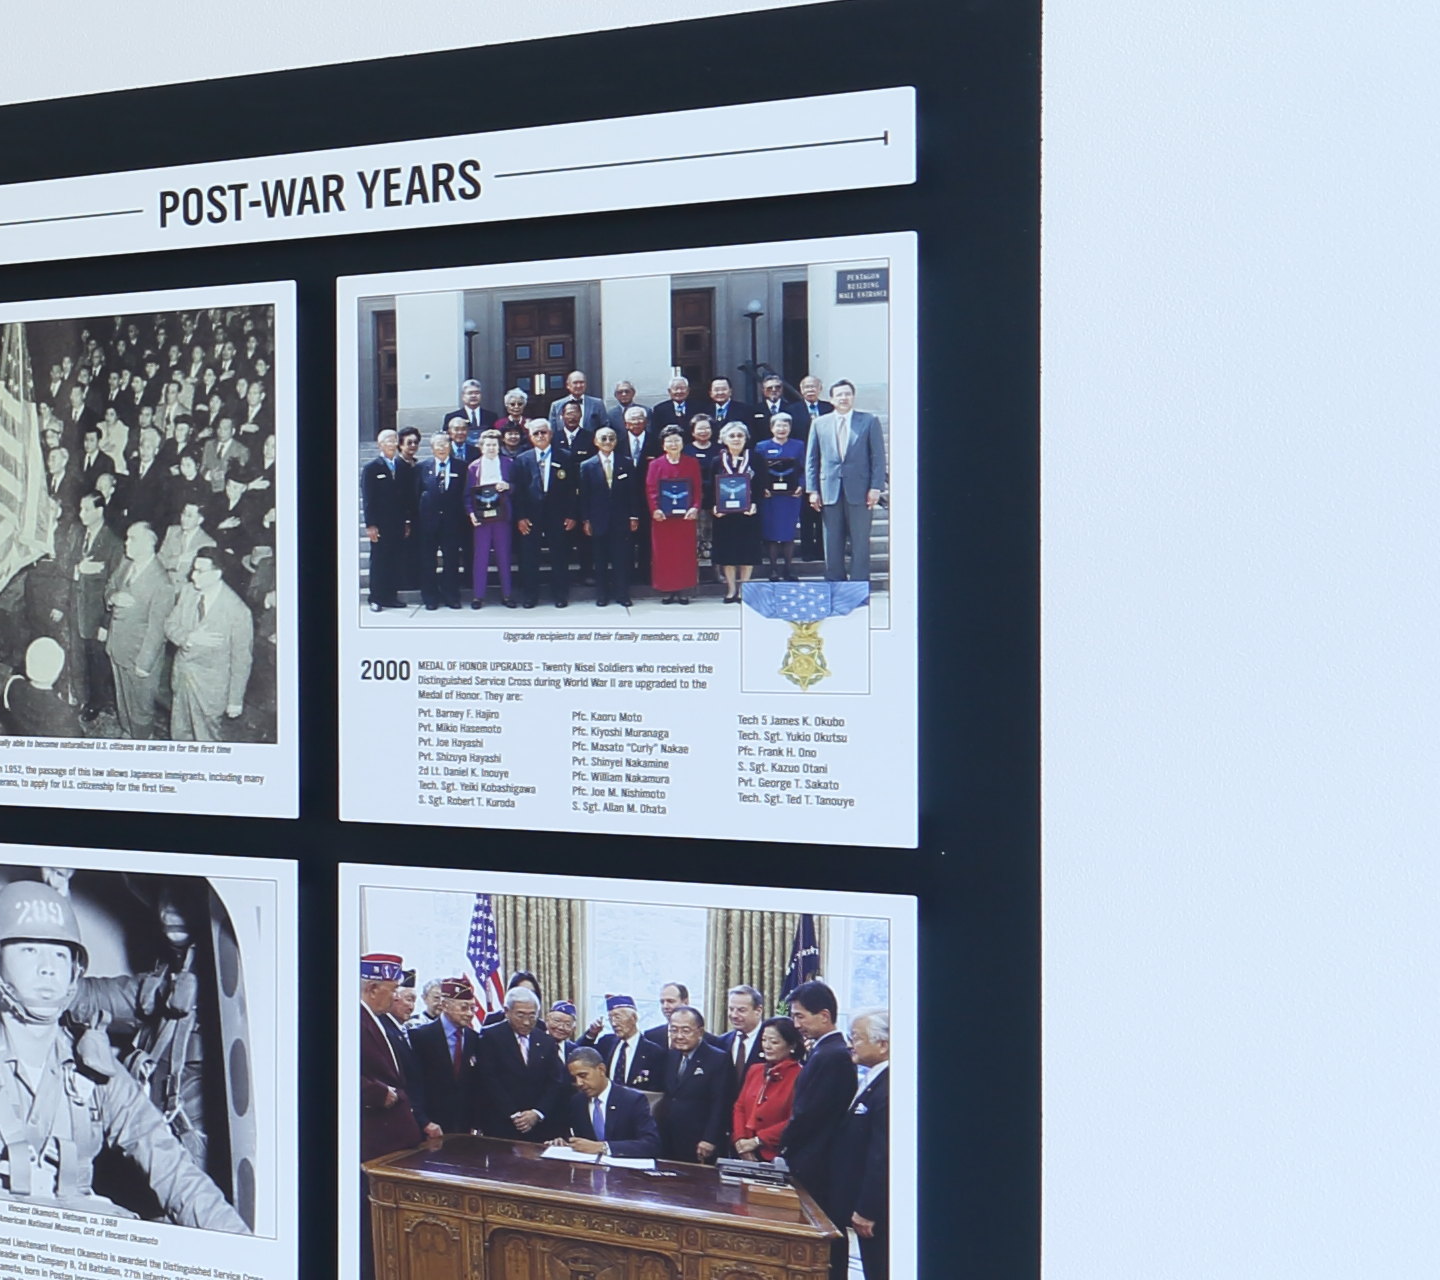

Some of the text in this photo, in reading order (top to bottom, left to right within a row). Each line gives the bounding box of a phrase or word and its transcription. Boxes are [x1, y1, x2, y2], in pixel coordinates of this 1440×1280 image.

[160, 159, 481, 228] POST-WAR YEARS
[361, 660, 410, 680] 2000
